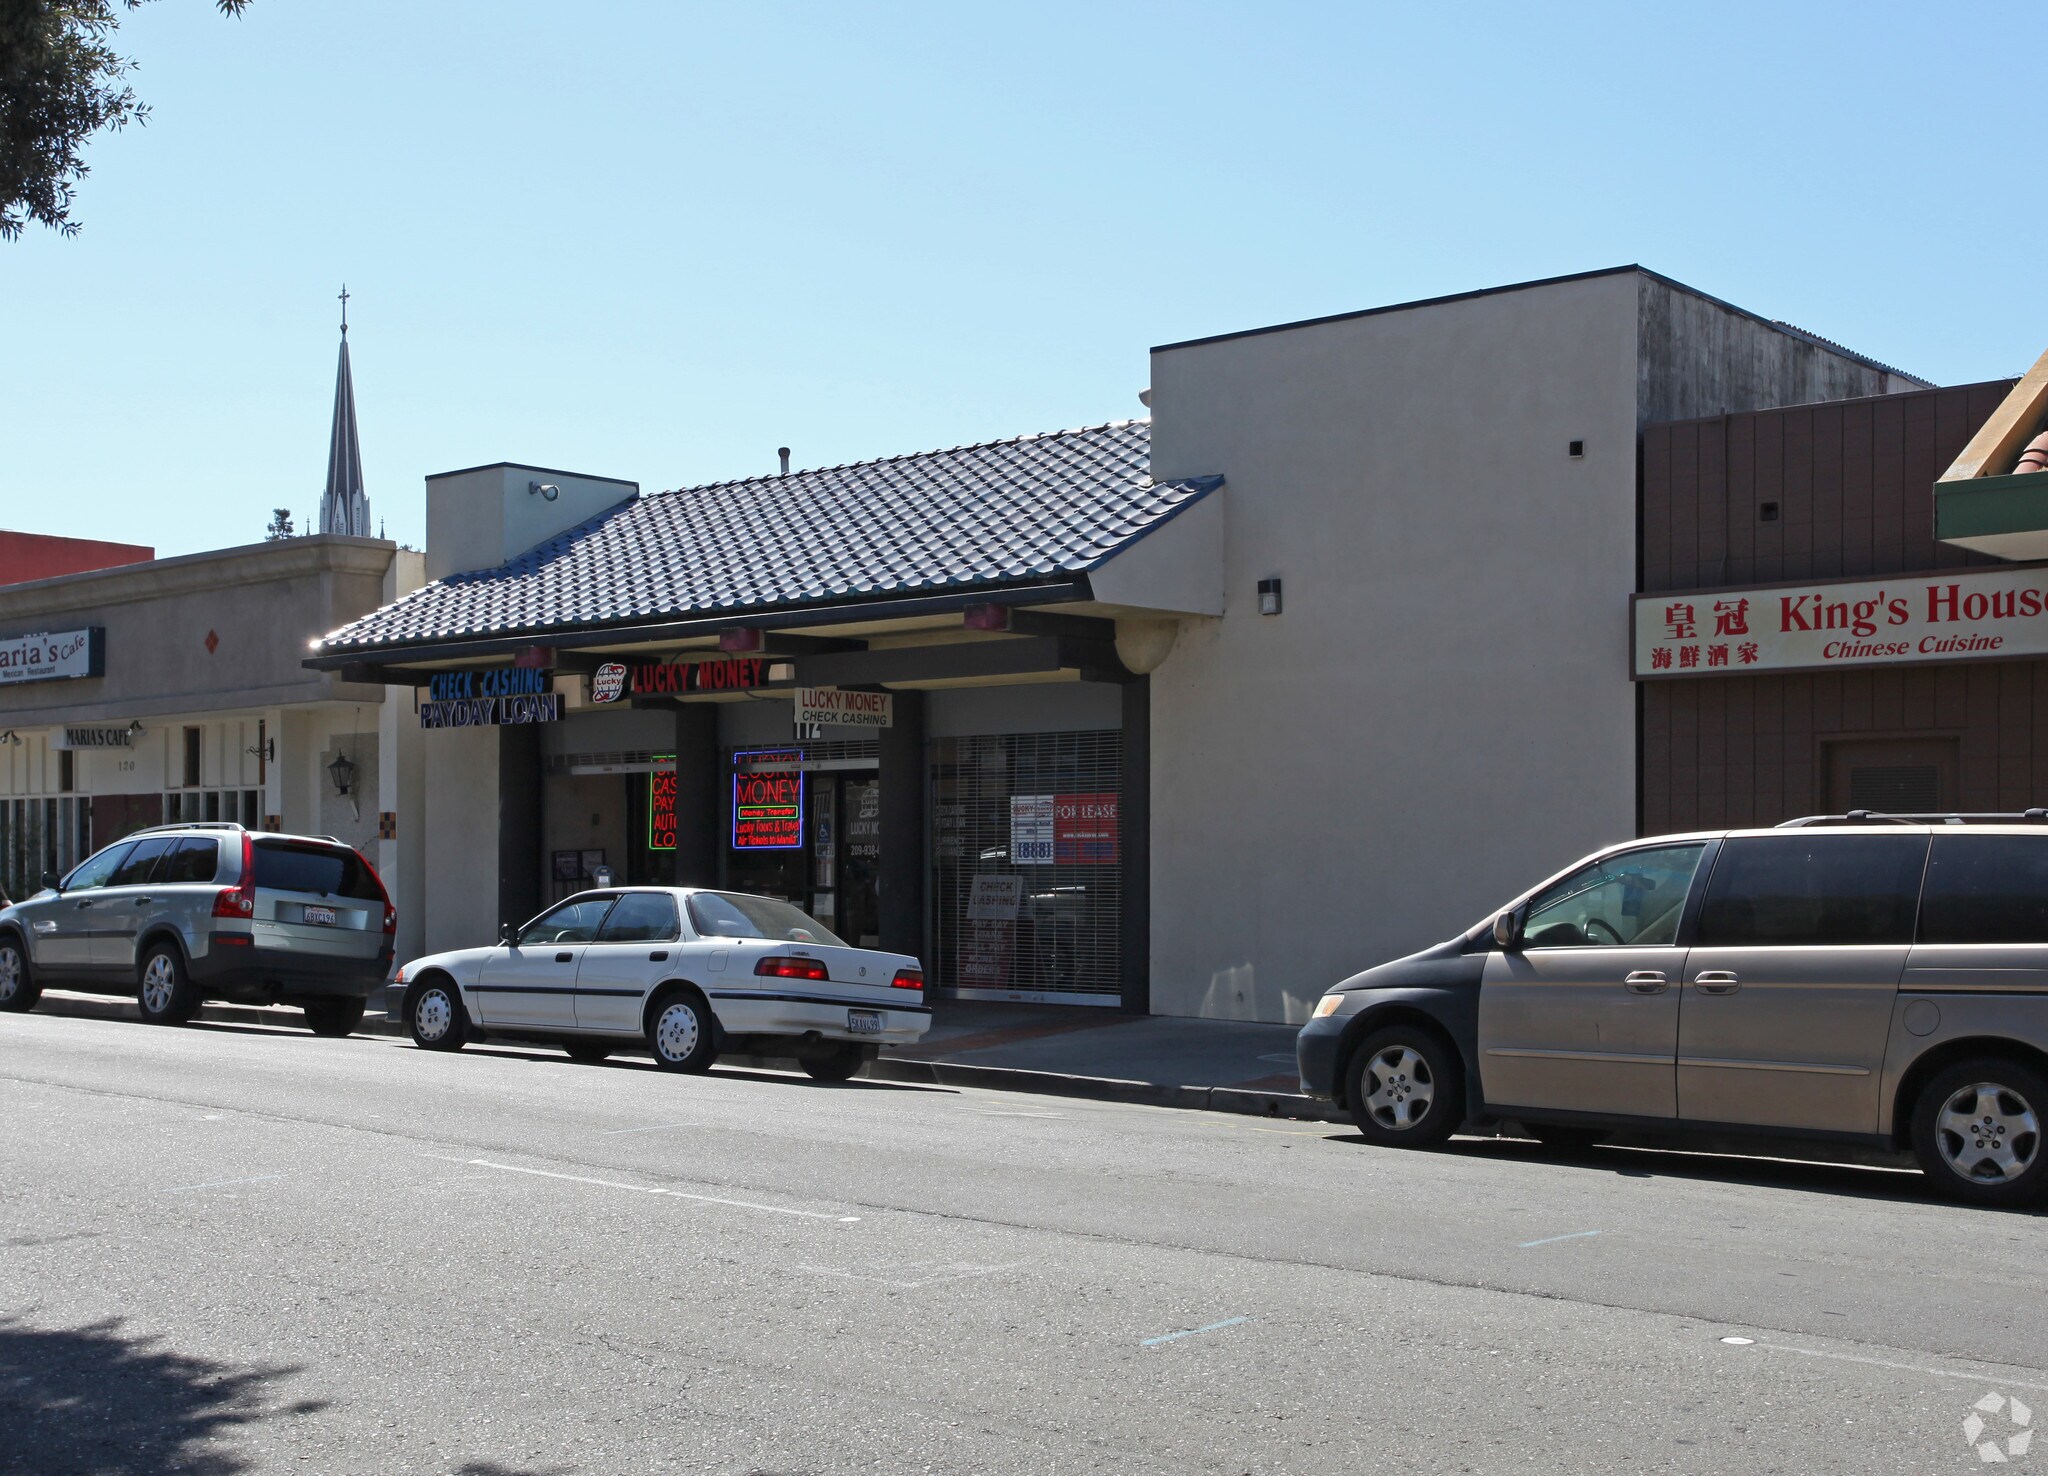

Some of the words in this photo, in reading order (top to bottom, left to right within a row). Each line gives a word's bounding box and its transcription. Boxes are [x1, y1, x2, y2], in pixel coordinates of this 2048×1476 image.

[1664, 598, 1749, 639] 皇冠
[1780, 591, 1909, 637] King's
[1926, 584, 2048, 623] Hous
[61, 635, 85, 660] Cafe
[1823, 640, 1910, 658] Chinese
[1918, 633, 2004, 654] Cuisine
[1652, 641, 1759, 669] 海鮮酒家
[3, 669, 24, 678] Mexican
[27, 665, 56, 676] Restaurant
[632, 663, 689, 694] LUCKY
[699, 658, 763, 689] MONEY
[430, 671, 473, 701] CHECK
[482, 667, 545, 697] CASHING
[596, 678, 622, 686] Lucky
[802, 690, 841, 709] LUCKY
[845, 693, 887, 712] MONEY
[421, 698, 496, 728] PAYDAY
[499, 694, 557, 725] LOAN
[802, 710, 838, 722] CHECK
[842, 713, 887, 725] CASHING
[66, 728, 104, 746] MARIA'S
[106, 729, 130, 746] CAFE
[118, 761, 135, 771] 120
[737, 779, 800, 804] MONEY
[654, 796, 676, 811] PAY
[1082, 804, 1117, 818] LEASE
[741, 809, 764, 817] Money
[766, 808, 795, 816] Transfer
[654, 813, 677, 830] AUT
[736, 821, 754, 835] Lucky
[756, 820, 773, 832] Tours
[851, 821, 870, 835] LUCKY
[654, 832, 677, 846] LO
[306, 912, 335, 924] 6BXC196
